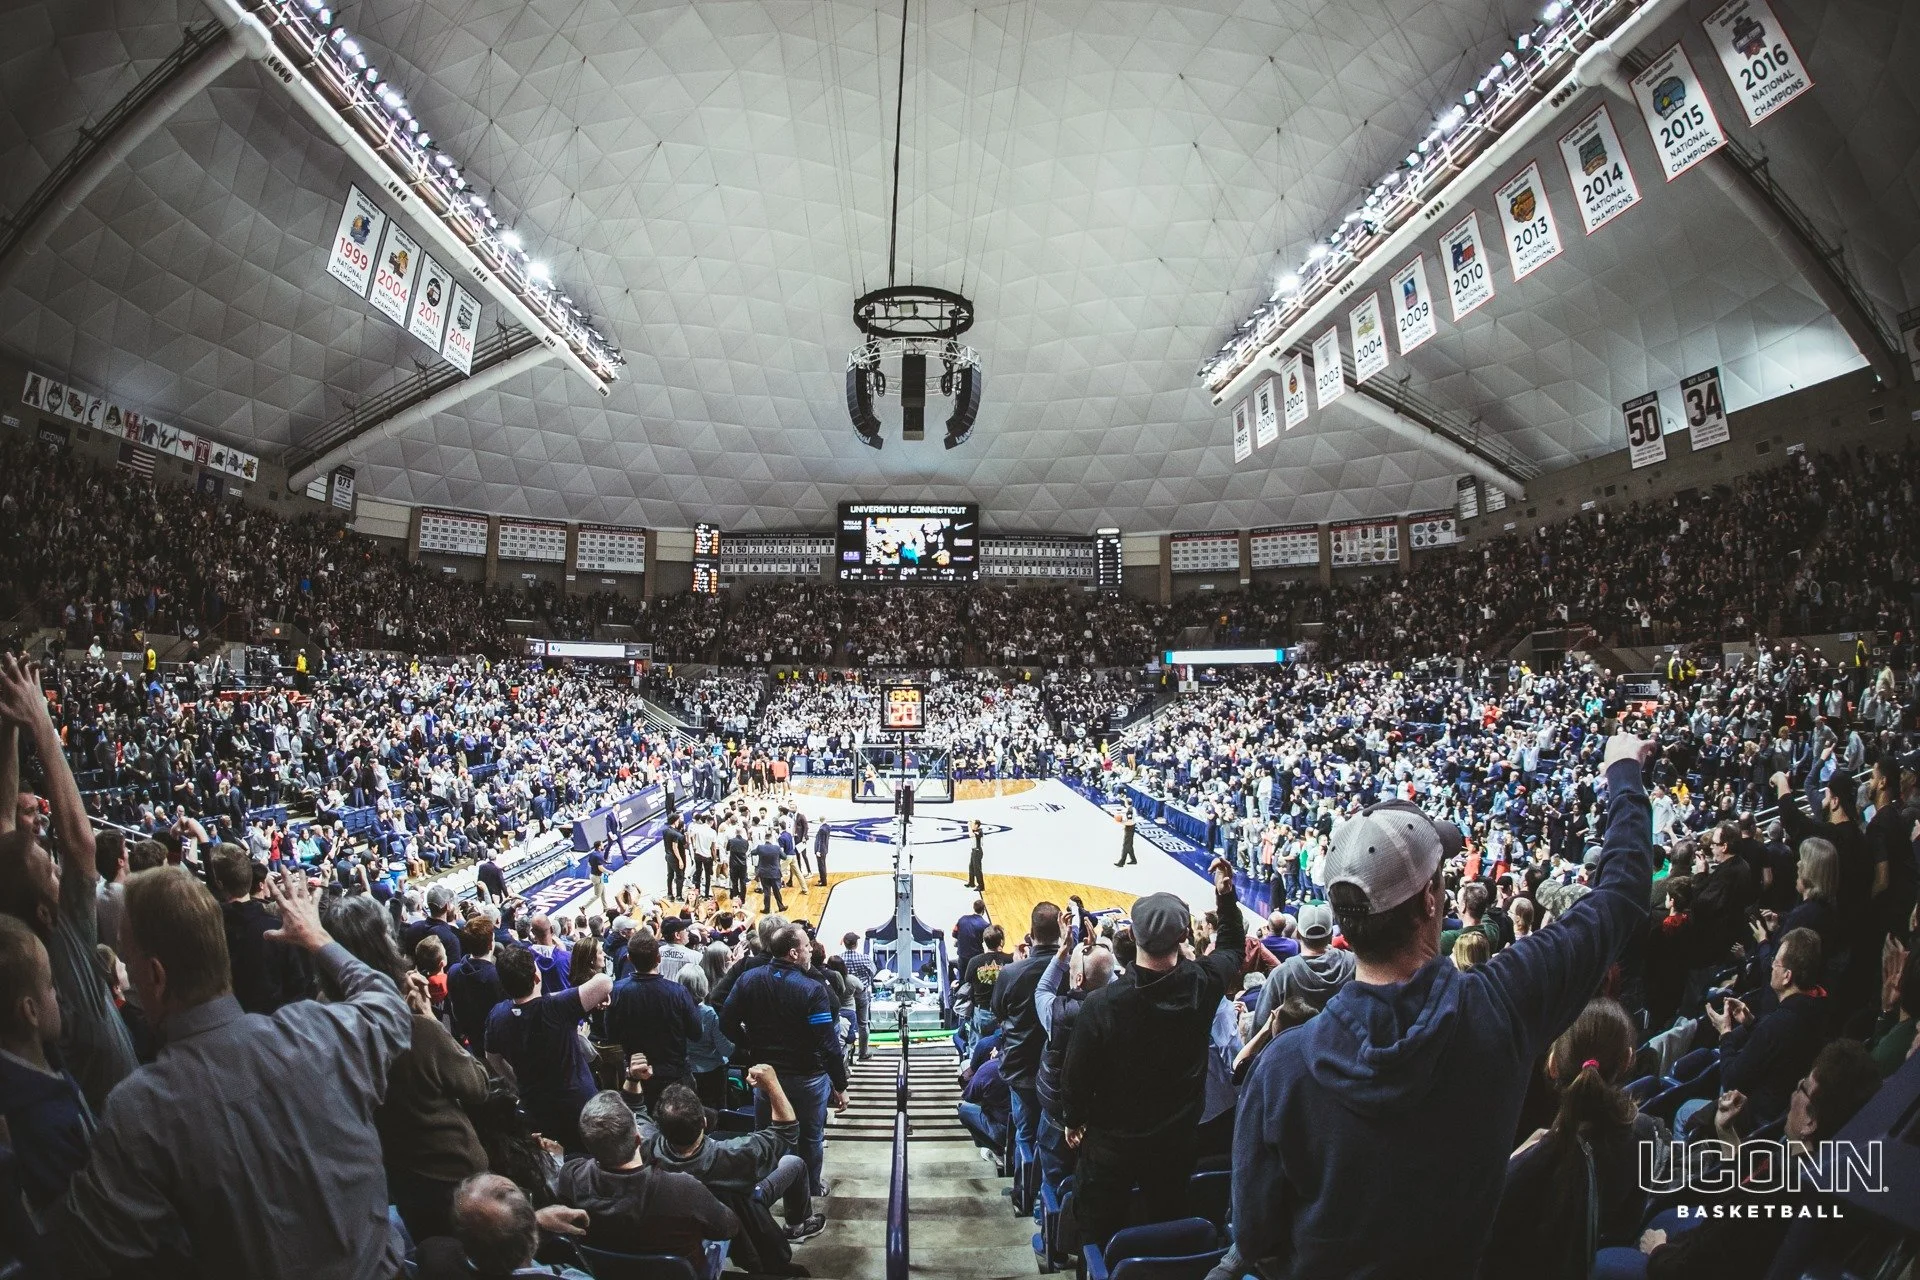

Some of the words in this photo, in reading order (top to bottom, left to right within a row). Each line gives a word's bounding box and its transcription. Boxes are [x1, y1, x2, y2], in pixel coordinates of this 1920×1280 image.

[1740, 44, 1788, 91] 2016
[1752, 70, 1796, 102] NATIONAL
[1754, 79, 1804, 116] CHAMPIONS
[1660, 104, 1704, 149] 2015
[1670, 129, 1710, 159] NATIONAL
[1672, 137, 1717, 172] CHAMPIONS
[1583, 163, 1623, 204] 2014
[1590, 186, 1626, 213] NATIONAL
[1591, 194, 1633, 226] CHAMPIONS
[1514, 216, 1548, 252] 2013
[340, 238, 368, 270] 1999
[1519, 239, 1550, 260] NATIONAL
[1519, 246, 1555, 273] CHAMPIONS
[332, 266, 362, 292] CHAMPIONS
[337, 257, 362, 281] NATIONAL
[1454, 263, 1483, 295] 2010
[378, 270, 406, 302] 2004
[379, 289, 400, 310] NATIONAL
[1458, 284, 1484, 302] NATIONAL
[375, 297, 401, 321] CHAMPIONS
[419, 302, 440, 328] 2011
[1458, 290, 1488, 314] CHAMPIONS
[417, 319, 436, 337] NATIONAL
[1400, 302, 1428, 332] 2009
[413, 326, 436, 347] CHAMPIONS
[450, 328, 470, 352] 2014
[1357, 335, 1382, 362] 2004
[1319, 367, 1339, 389] 2003
[1286, 391, 1303, 412] 2002
[1687, 382, 1722, 426] 34
[1258, 413, 1274, 431] 2000
[1628, 406, 1660, 446] 50
[39, 430, 66, 445] UCONN
[1236, 432, 1248, 447] 1995
[338, 476, 351, 488] 873
